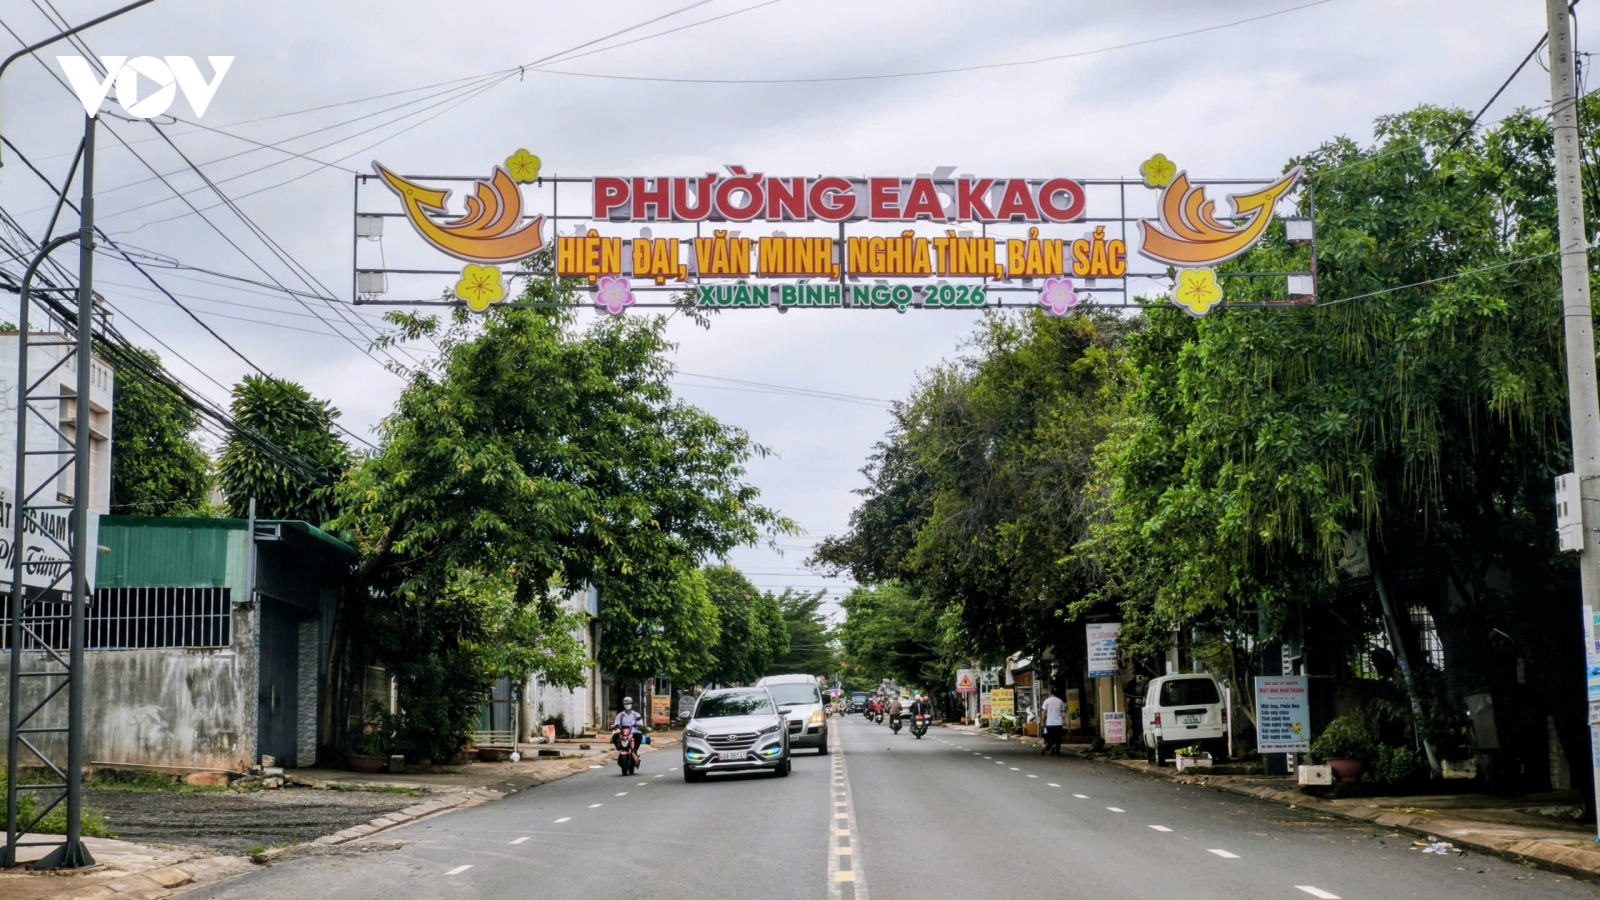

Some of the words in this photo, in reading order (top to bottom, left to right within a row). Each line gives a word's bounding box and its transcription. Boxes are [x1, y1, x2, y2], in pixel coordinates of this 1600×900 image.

[592, 164, 857, 222] PHƯỜNG
[954, 176, 1086, 222] KAO
[556, 229, 622, 284] HIỆN
[632, 237, 689, 285] ĐẠI,
[692, 229, 750, 277] VĂN
[758, 236, 841, 281] MINH,
[847, 229, 932, 276] NGHĨA
[933, 229, 1004, 281] TÌNH,
[1007, 226, 1063, 277] BẢN
[1072, 226, 1127, 277] SẮC
[697, 279, 771, 307] XUÂN
[779, 279, 842, 307] BÍNH
[852, 284, 913, 312] NGỌ
[922, 284, 986, 307] 2026
